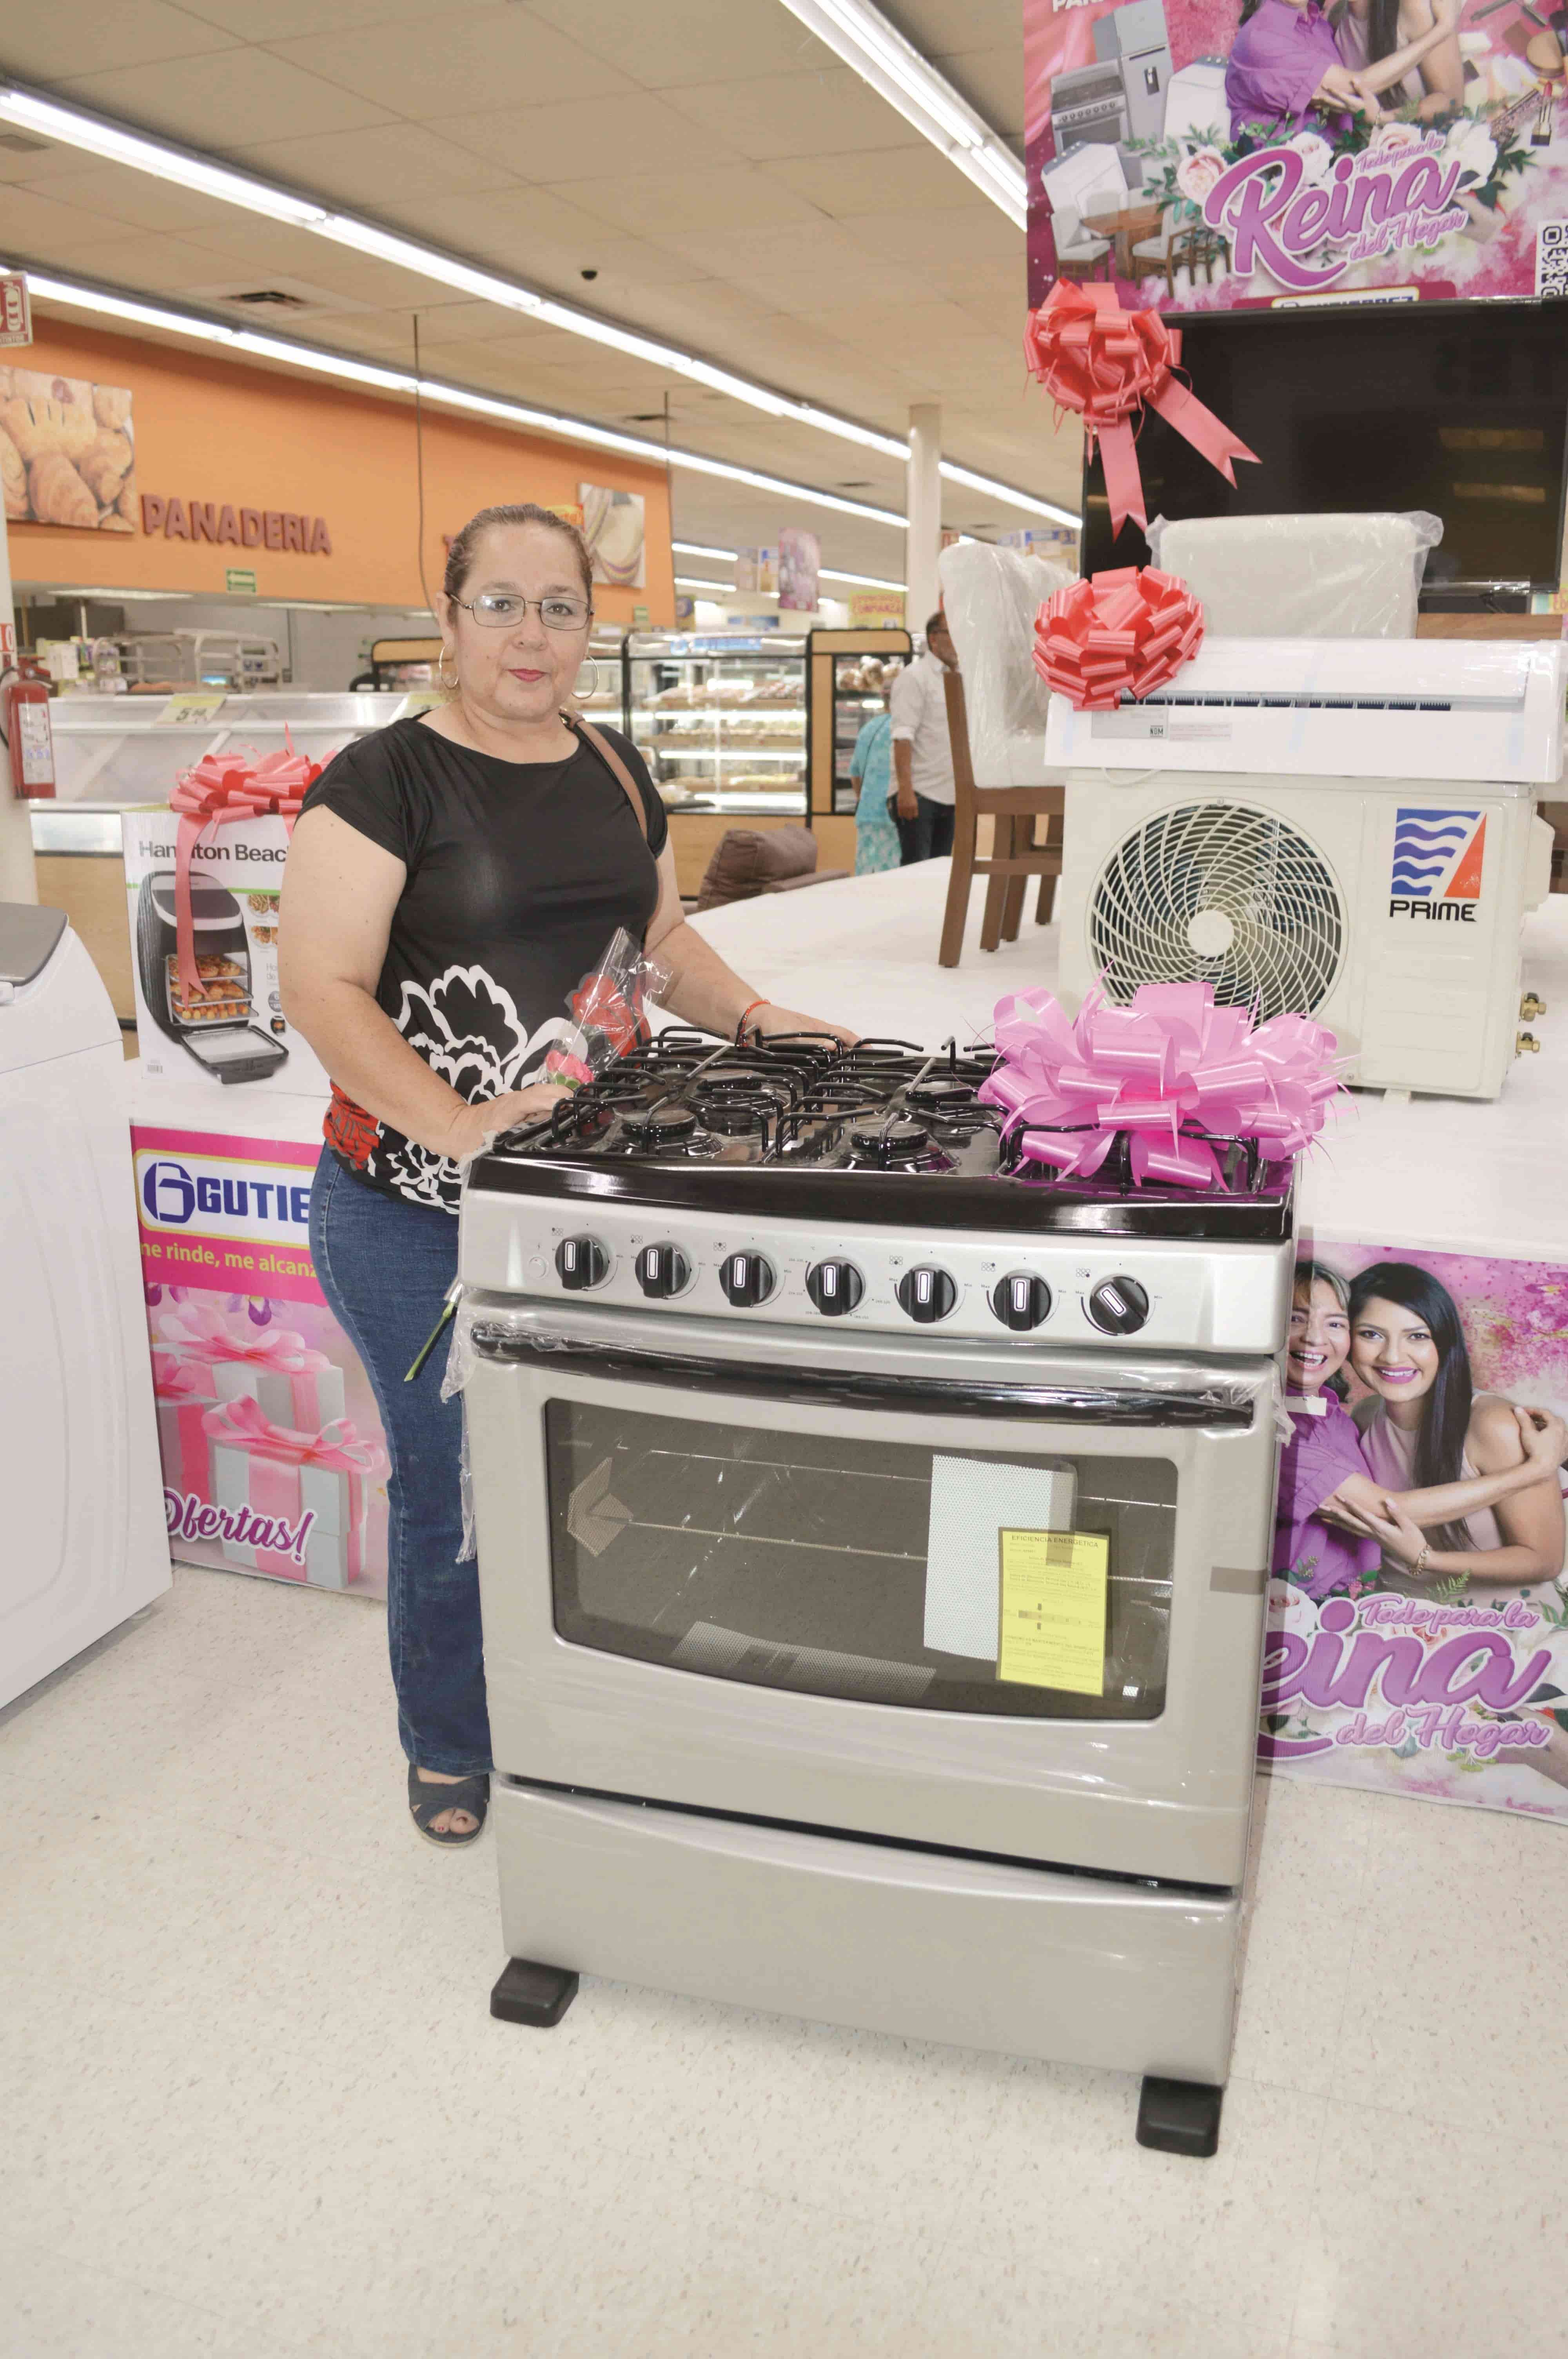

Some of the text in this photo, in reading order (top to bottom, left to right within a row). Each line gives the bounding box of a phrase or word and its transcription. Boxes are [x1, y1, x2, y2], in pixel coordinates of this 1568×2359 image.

[1205, 149, 1461, 287] Reina
[1351, 210, 1466, 260] del Hogar
[141, 493, 332, 556] PANADERIA
[235, 843, 289, 862] Beac
[1390, 900, 1477, 922] PRIME
[197, 1177, 312, 1224] GUTIE
[166, 1242, 220, 1268] rinde,
[224, 1252, 254, 1269] me
[258, 1253, 318, 1278] alcanz
[1011, 1535, 1098, 1548] EFICIENCIA ENERGETICA
[1359, 1594, 1540, 1634] Todo para la
[1262, 1600, 1552, 1710] eina
[1336, 1705, 1551, 1757] del Hogar
